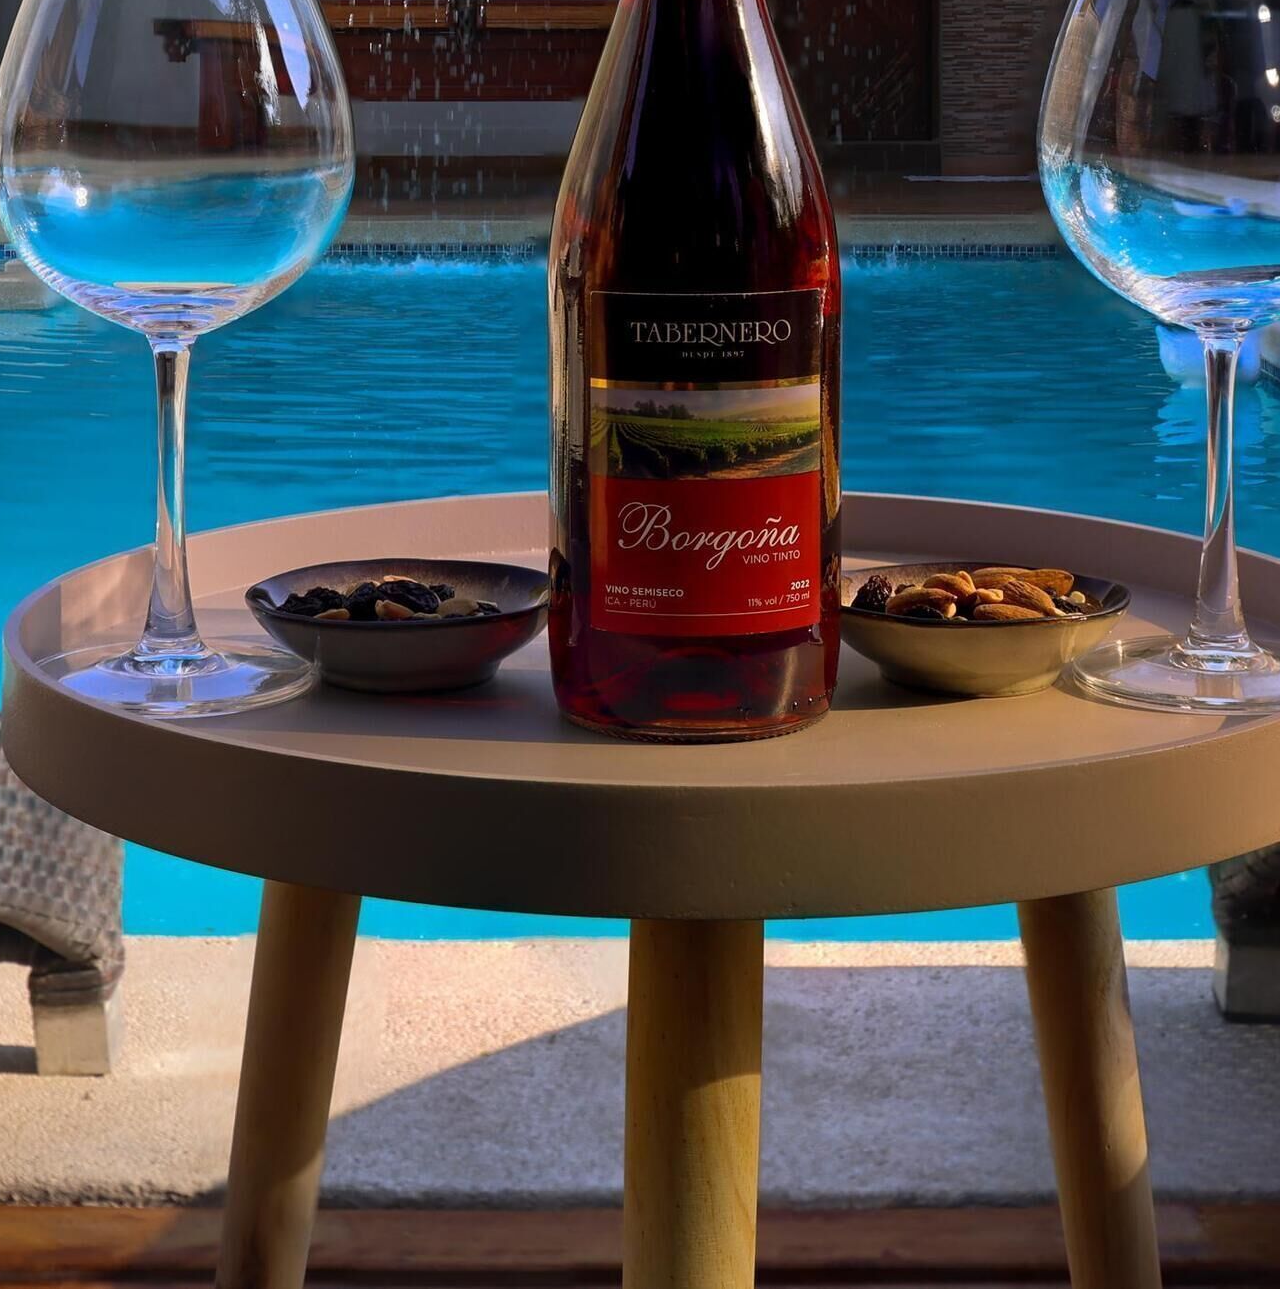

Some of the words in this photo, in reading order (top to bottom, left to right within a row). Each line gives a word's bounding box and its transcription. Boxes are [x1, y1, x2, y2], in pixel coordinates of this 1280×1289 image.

[630, 319, 792, 347] TABERNERO
[722, 349, 745, 359] 1897
[617, 501, 800, 571] Borgoña
[742, 553, 770, 564] VINO
[772, 549, 801, 561] TINTO
[605, 584, 630, 595] VINO
[631, 586, 684, 598] SEMISECO
[790, 579, 810, 591] 2022
[604, 596, 621, 606] ICA
[748, 597, 762, 607] 11%
[764, 595, 778, 606] vol
[785, 592, 800, 603] 750
[801, 590, 810, 600] ml
